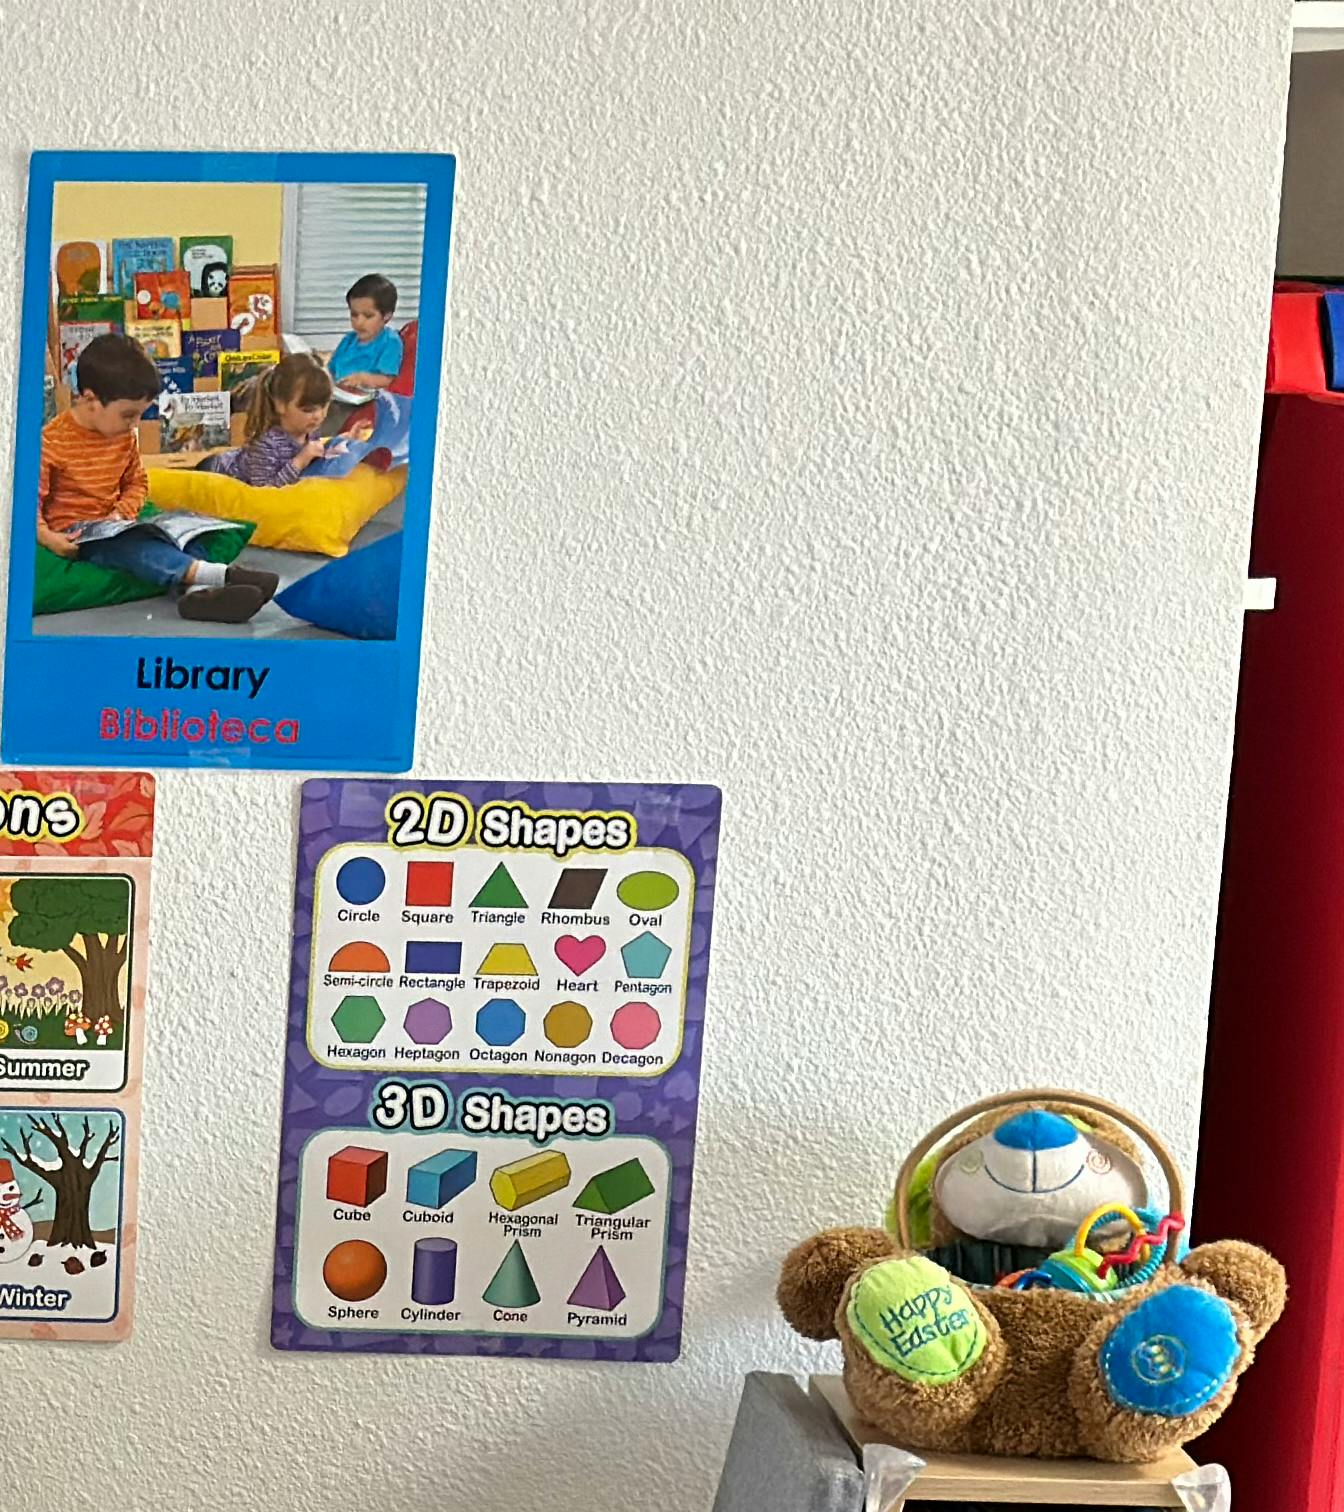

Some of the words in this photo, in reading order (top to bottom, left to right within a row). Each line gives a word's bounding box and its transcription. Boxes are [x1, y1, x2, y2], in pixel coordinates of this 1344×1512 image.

[137, 657, 270, 698] Library
[99, 708, 300, 745] Biblioteca
[389, 796, 468, 846] 2D
[481, 807, 630, 855] Shapes
[337, 909, 380, 923] Circle
[401, 910, 454, 925] Square
[470, 911, 525, 925] Triangle
[541, 912, 610, 926] Rhombus
[628, 913, 662, 927] Oval
[323, 974, 393, 989] Semi-circle
[399, 976, 466, 990] Rectangle
[473, 977, 540, 992] Trapezoid
[556, 979, 598, 993] Heart
[614, 981, 672, 995] Pentagon
[327, 1046, 386, 1059] Hexagon
[394, 1047, 460, 1062] Heptagon
[469, 1048, 527, 1062] Octagon
[534, 1050, 596, 1064] Nonagon
[601, 1052, 663, 1066] Decagon
[374, 1082, 448, 1129] 3D
[462, 1091, 610, 1142] Shapes
[333, 1209, 371, 1222] Cube
[402, 1210, 454, 1224] Cuboid
[488, 1212, 559, 1227] Hexagonal
[575, 1214, 651, 1231] Triangular
[503, 1224, 542, 1239] Prism
[590, 1227, 633, 1242] Prism
[328, 1306, 379, 1320] Sphere
[401, 1308, 460, 1322] Cylinder
[493, 1310, 527, 1322] Cone
[879, 1286, 953, 1334] Happy
[567, 1313, 627, 1327] Pyramid
[889, 1309, 969, 1358] Easter
